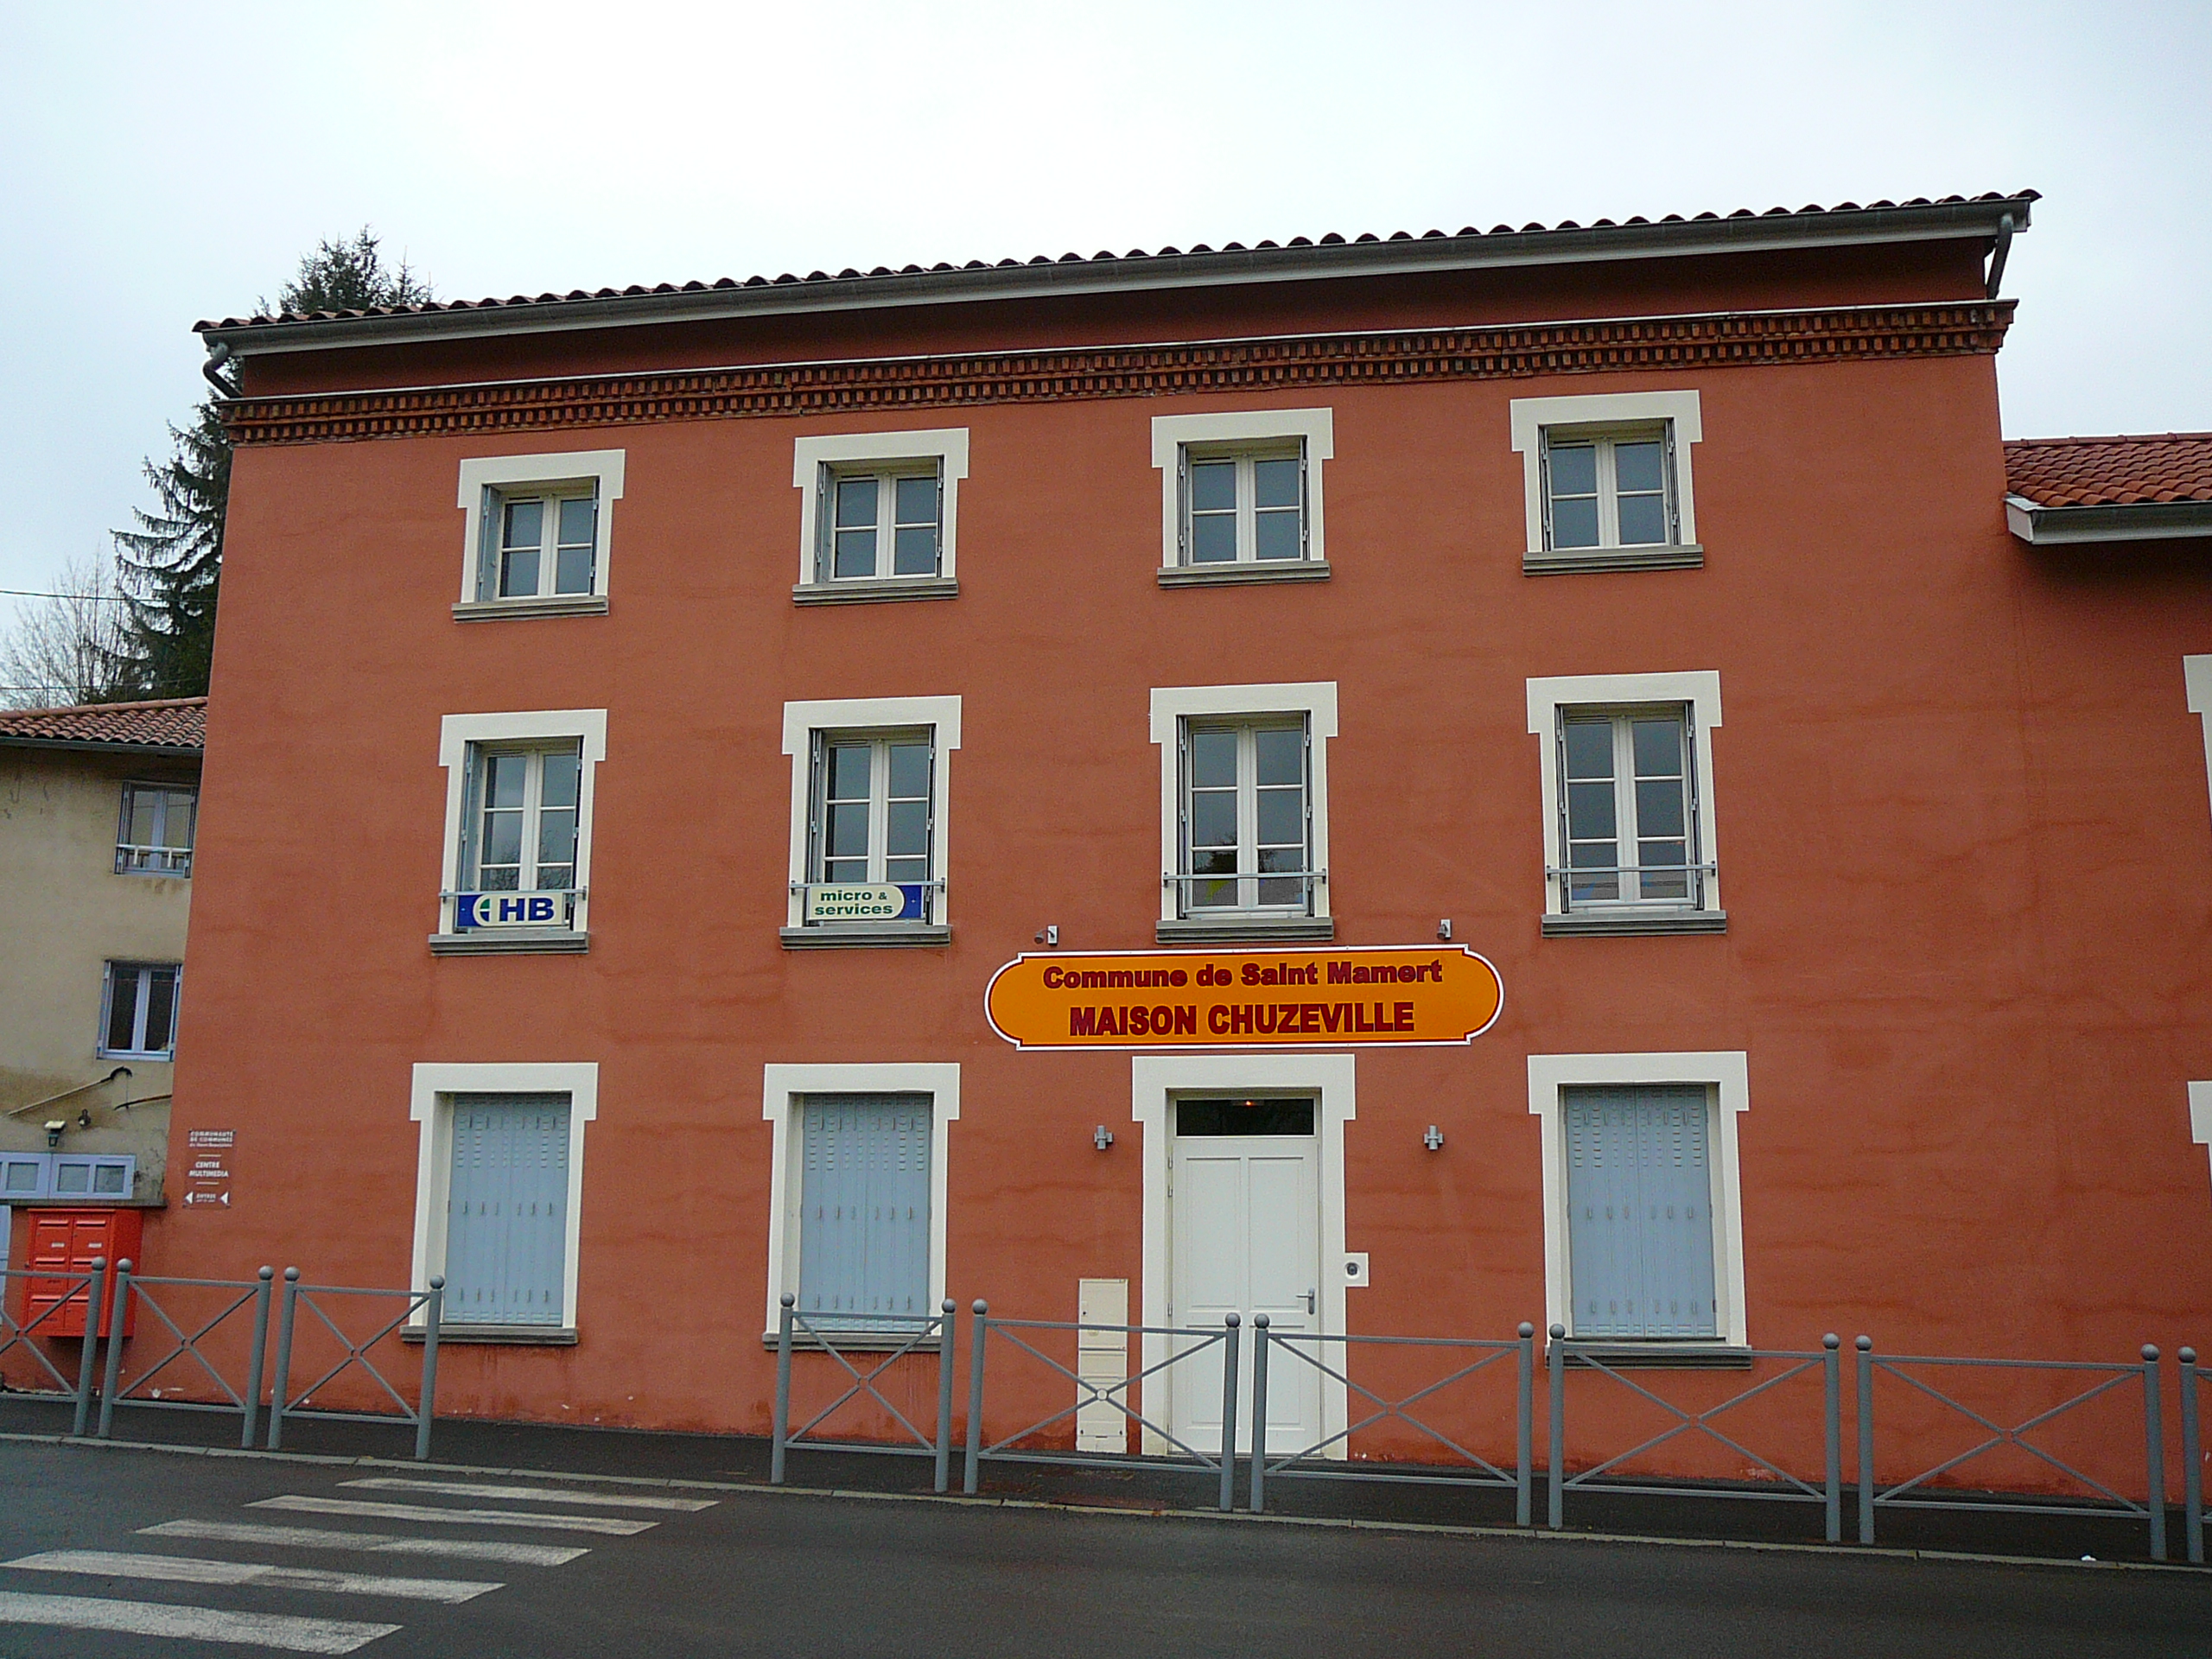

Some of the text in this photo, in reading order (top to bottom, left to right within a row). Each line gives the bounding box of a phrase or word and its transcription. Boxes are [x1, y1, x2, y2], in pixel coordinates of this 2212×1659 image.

[820, 889, 887, 901] micro &
[815, 903, 893, 916] services
[1042, 959, 1443, 989] Commune de Saint Mamert
[1069, 1001, 1415, 1037] MAISON CHUZEVILLE
